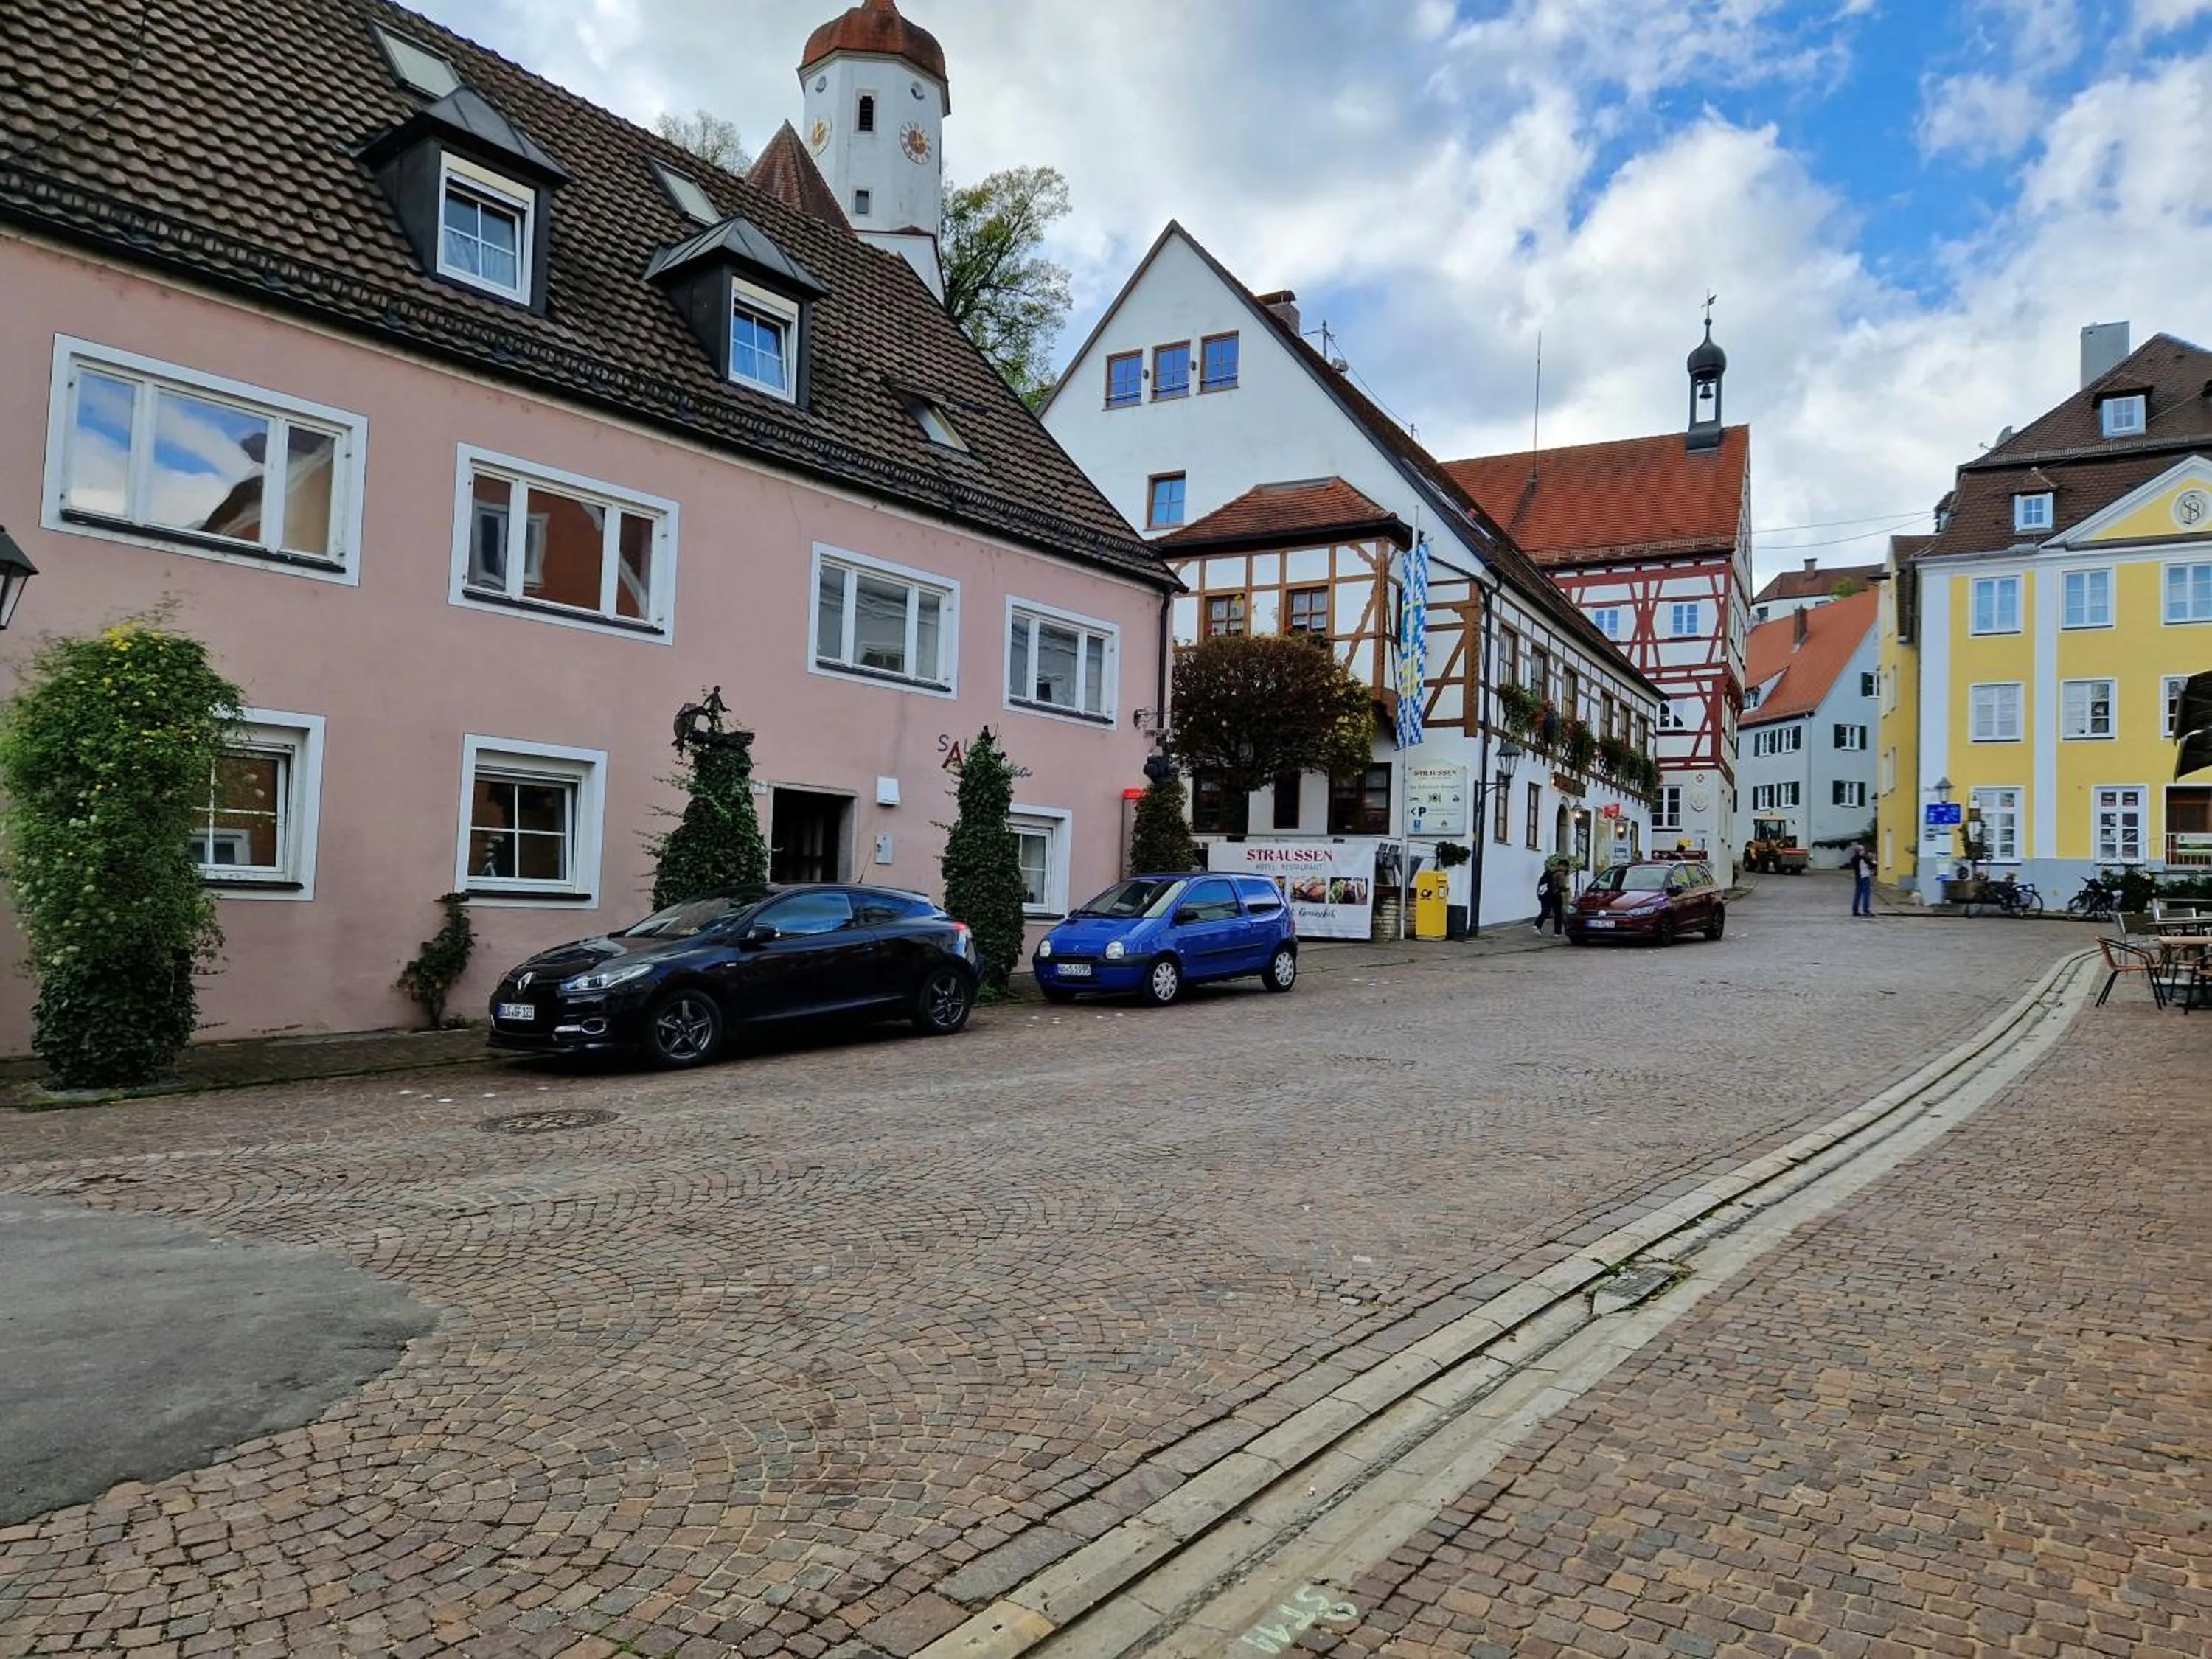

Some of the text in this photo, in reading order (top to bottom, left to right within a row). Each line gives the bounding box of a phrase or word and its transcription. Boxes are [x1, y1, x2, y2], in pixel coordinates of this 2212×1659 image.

[1418, 806, 1427, 818] P
[1246, 849, 1333, 862] STRAUSSEN
[1281, 863, 1323, 872] RESTAURANT
